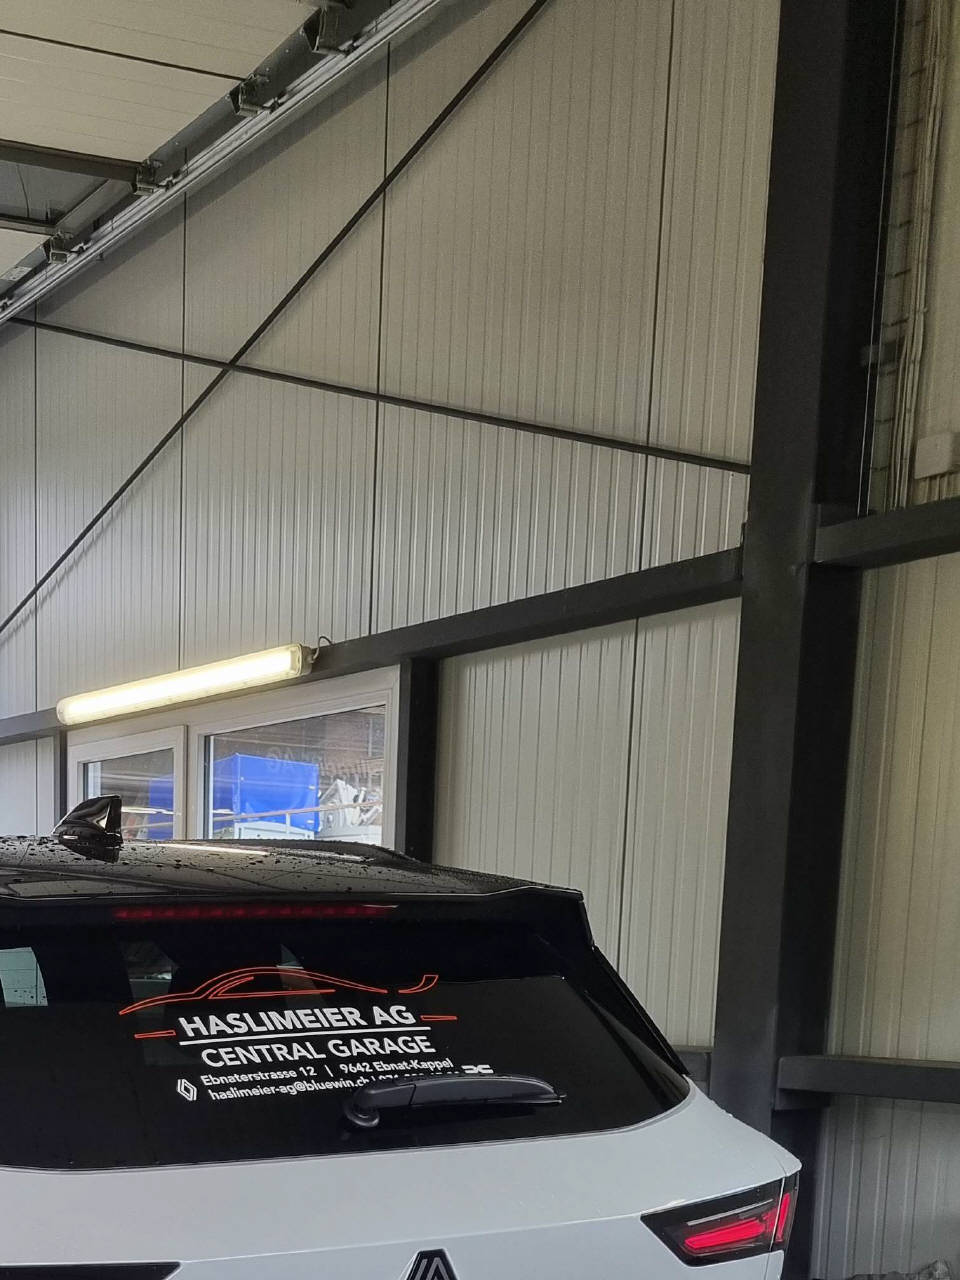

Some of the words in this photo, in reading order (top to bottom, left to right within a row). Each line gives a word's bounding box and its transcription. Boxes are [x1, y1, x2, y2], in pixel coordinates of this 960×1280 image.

[178, 1006, 369, 1038] HASLIMEIER
[372, 1005, 417, 1026] AG
[201, 1041, 326, 1068] CENTRAL
[327, 1035, 436, 1059] GARAGE
[200, 1068, 298, 1086] Ebnaterstrasse
[299, 1066, 318, 1077] 12
[340, 1062, 373, 1074] 9642
[373, 1058, 454, 1072] Ebnat-Kappel
